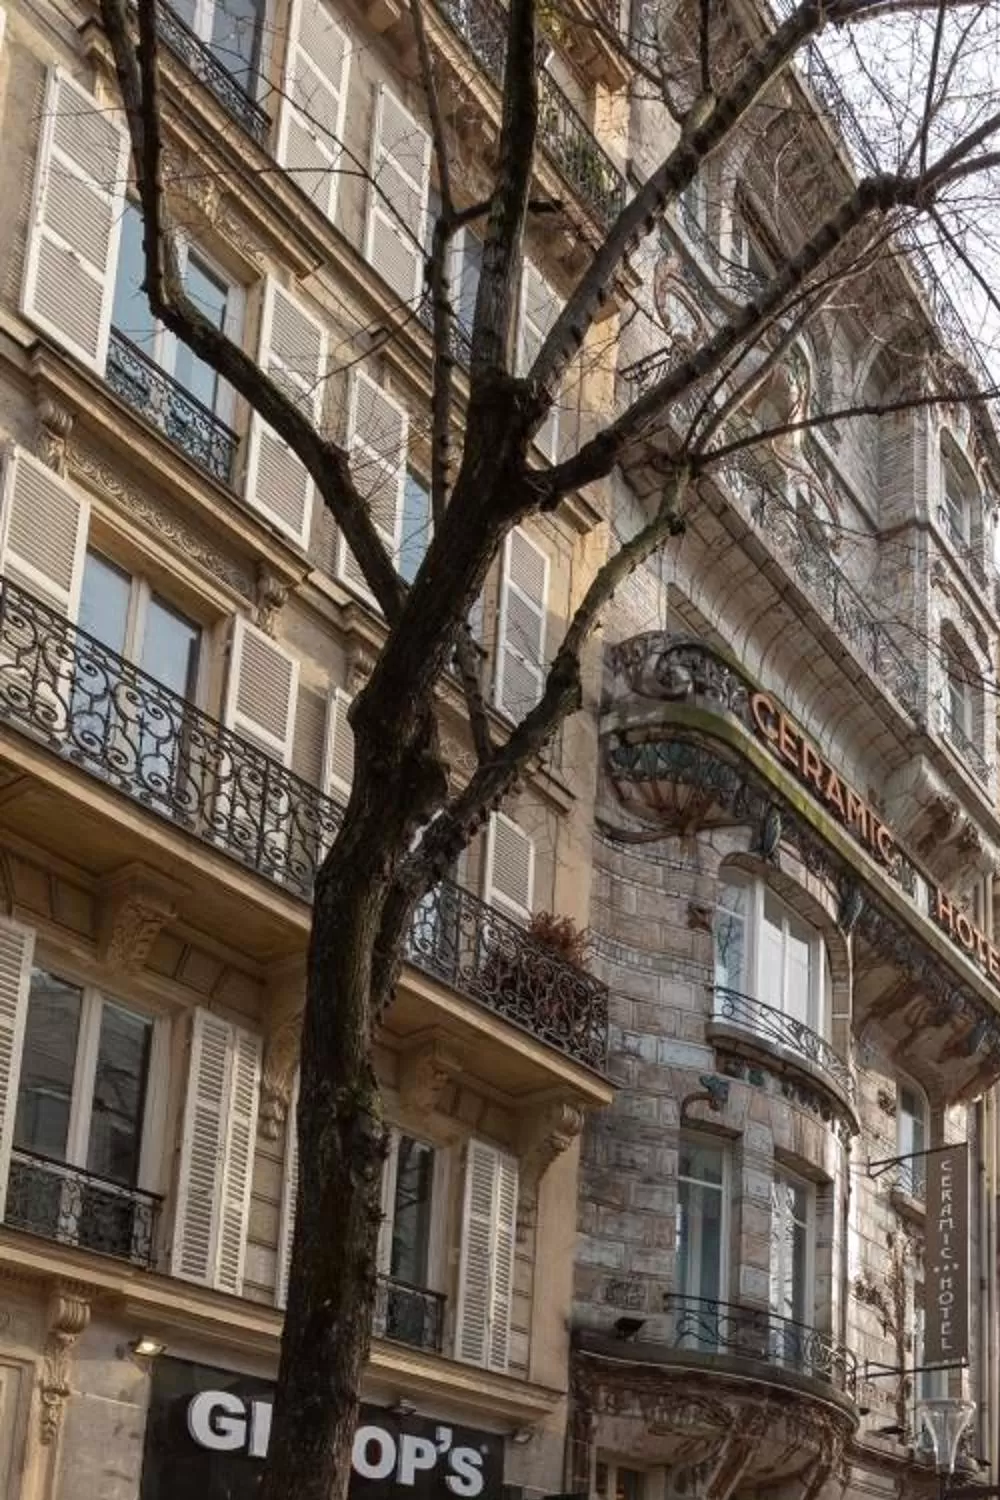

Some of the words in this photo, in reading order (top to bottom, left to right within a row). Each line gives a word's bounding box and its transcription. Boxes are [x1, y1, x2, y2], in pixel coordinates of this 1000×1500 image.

[752, 692, 894, 867] CERAMIC
[938, 1159, 953, 1259] CERAMIC
[938, 1277, 953, 1350] HOTEL
[188, 1390, 485, 1498] GLOP'S
